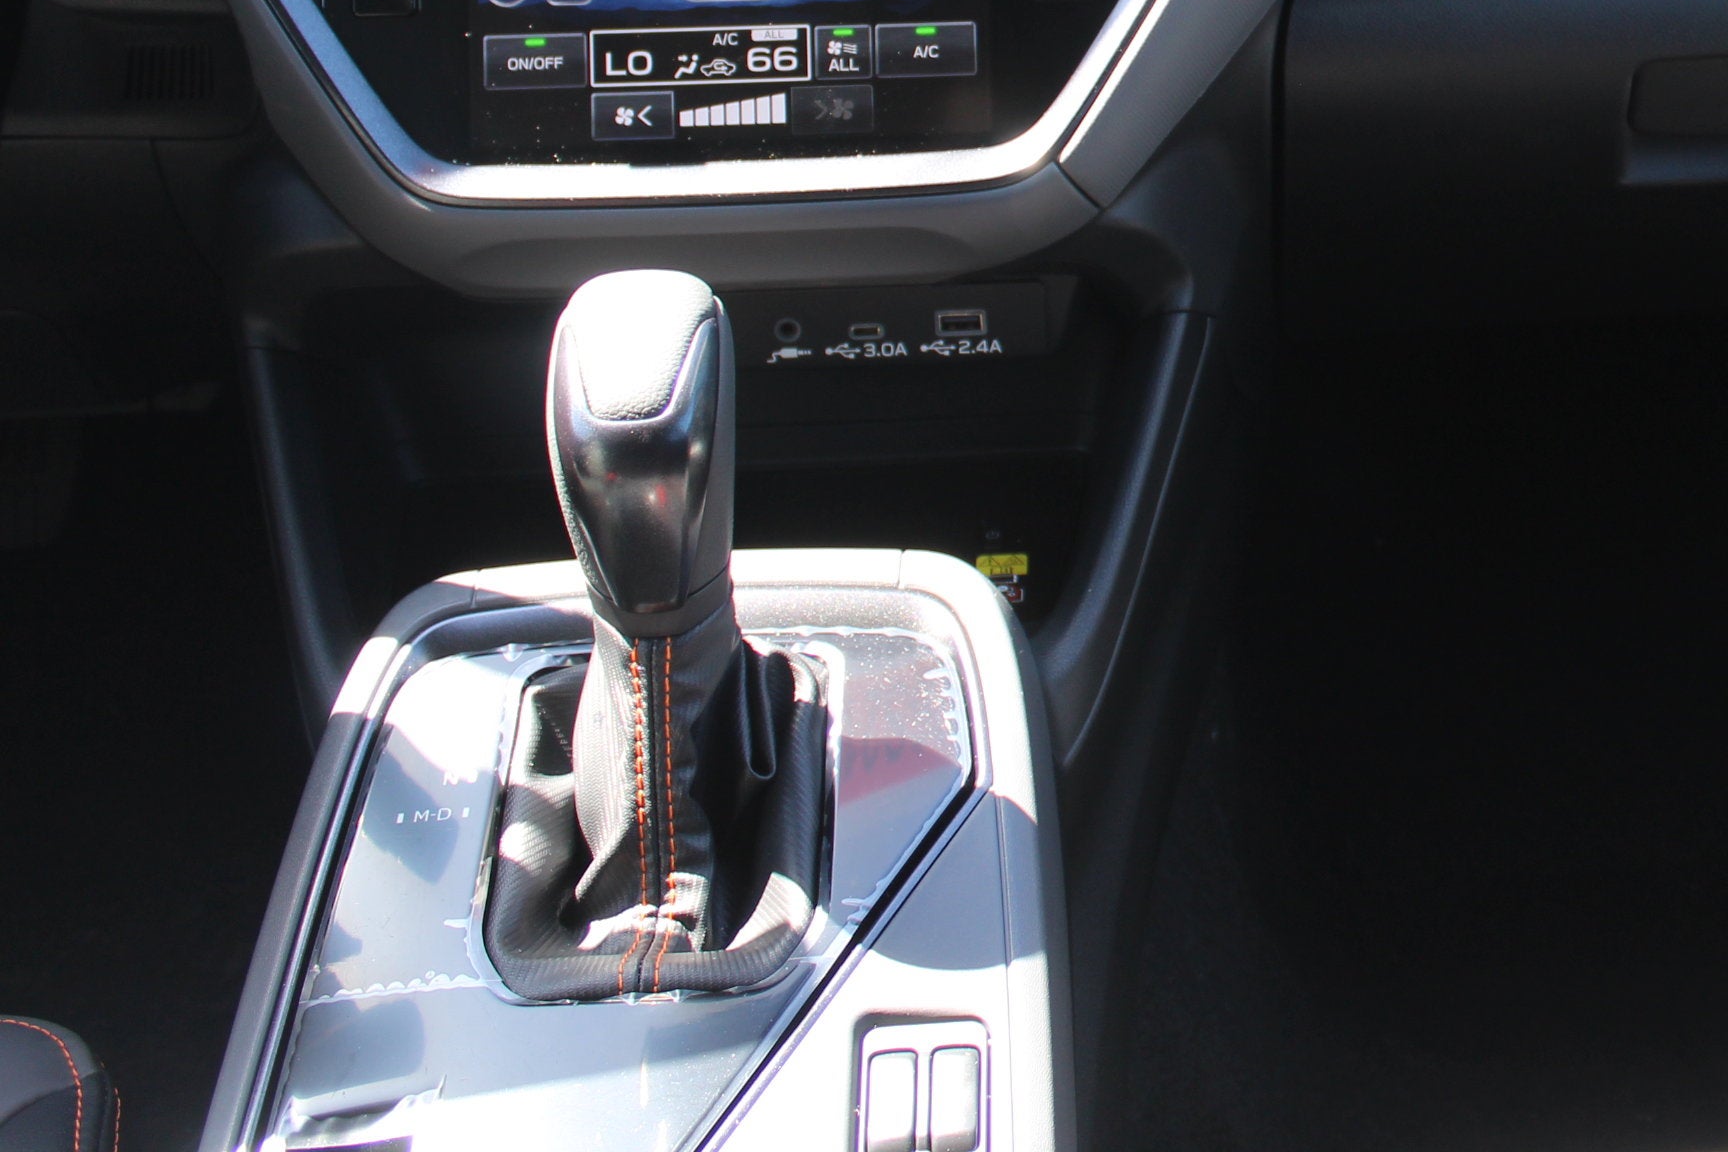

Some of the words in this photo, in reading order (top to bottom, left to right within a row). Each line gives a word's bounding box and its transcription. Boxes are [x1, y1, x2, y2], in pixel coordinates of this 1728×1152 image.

[712, 32, 739, 47] A/C
[913, 43, 940, 59] A/C
[507, 55, 564, 72] ON/OFF
[604, 50, 653, 77] LO
[746, 46, 799, 73] 66
[828, 57, 860, 73] ALL
[863, 342, 908, 358] 3.0A
[958, 339, 1003, 355] 2.4A
